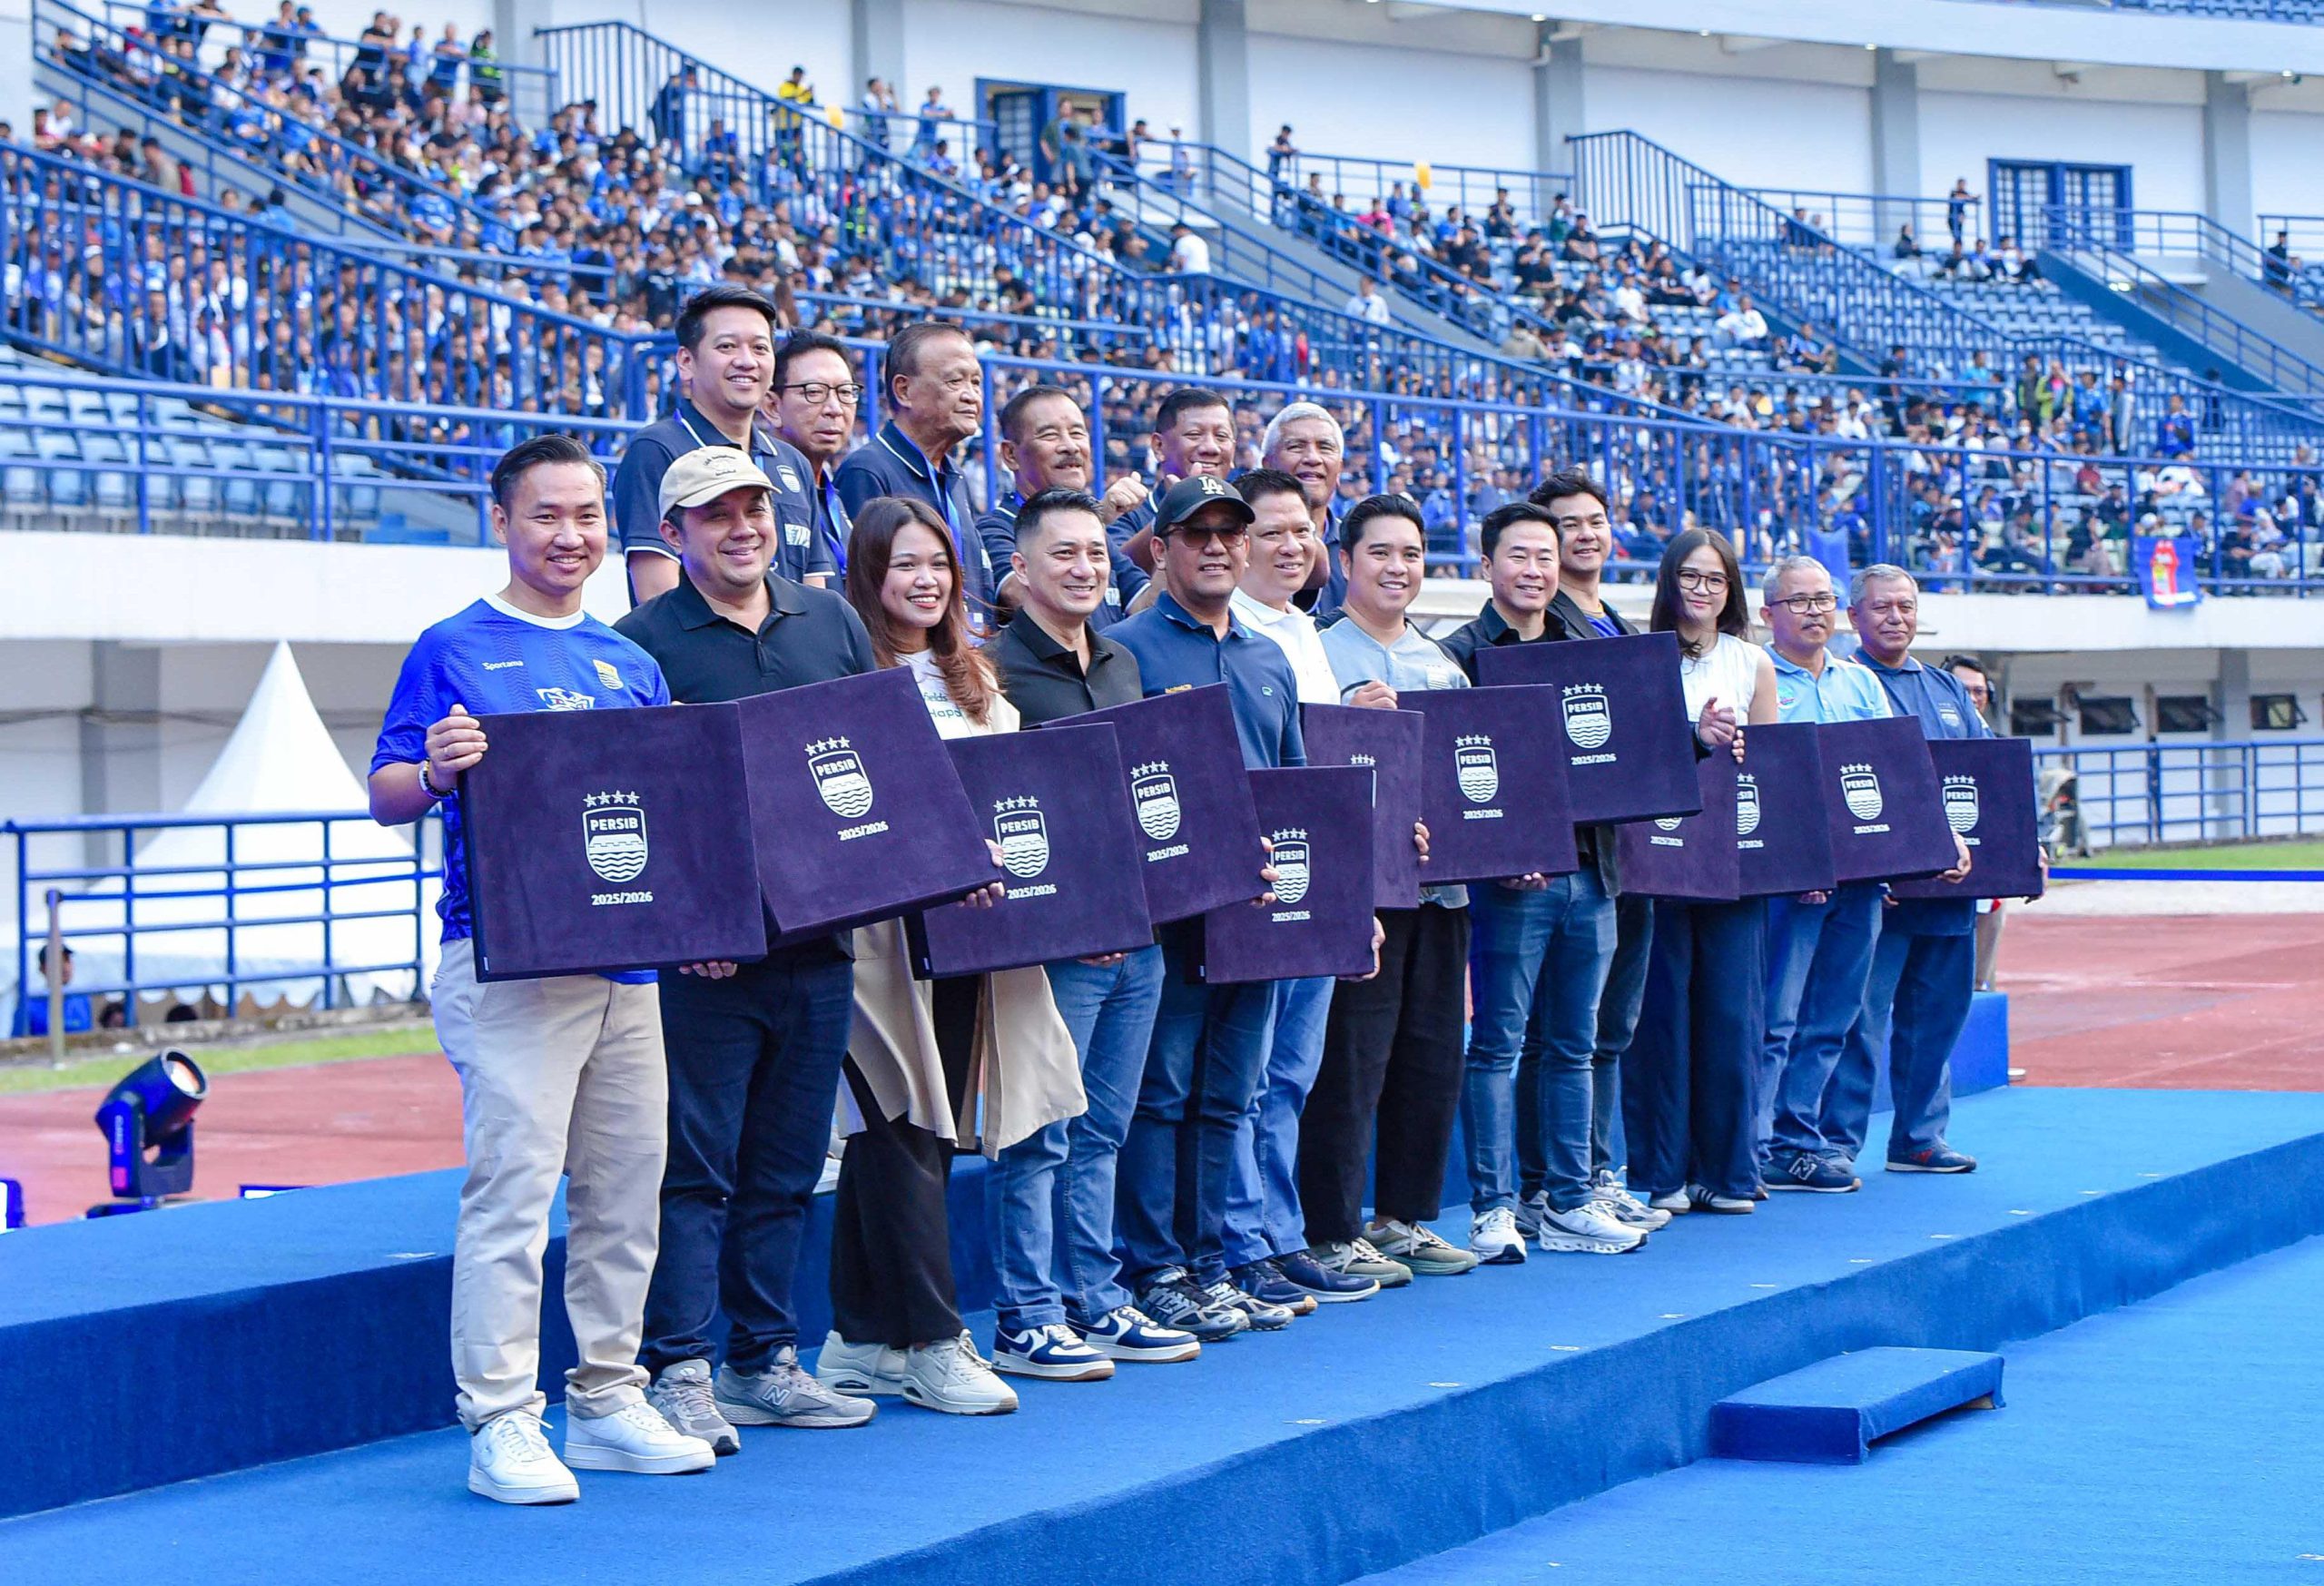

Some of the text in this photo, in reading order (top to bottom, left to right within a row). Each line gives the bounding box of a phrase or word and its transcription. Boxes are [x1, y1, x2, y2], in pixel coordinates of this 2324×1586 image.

[1198, 476, 1226, 496] LA
[482, 660, 524, 671] Sportama
[1567, 701, 1604, 714] PERSIB
[1460, 754, 1492, 765] PERSIB
[1571, 753, 1617, 765] 2025/2026
[815, 758, 857, 776] PERSIB
[1137, 782, 1171, 799] PERSIB
[1846, 778, 1875, 790] PERSIB
[1946, 791, 1974, 801] PERSIB
[589, 817, 639, 832] PERSIB
[837, 820, 890, 842] 2025/2026
[1000, 818, 1040, 833] PERSIB
[1147, 843, 1189, 862] 2025/2026
[1275, 850, 1306, 862] PERSIB
[591, 891, 654, 906] 2025/2026
[1006, 882, 1058, 900] 2025/2026
[762, 1384, 791, 1406] N
